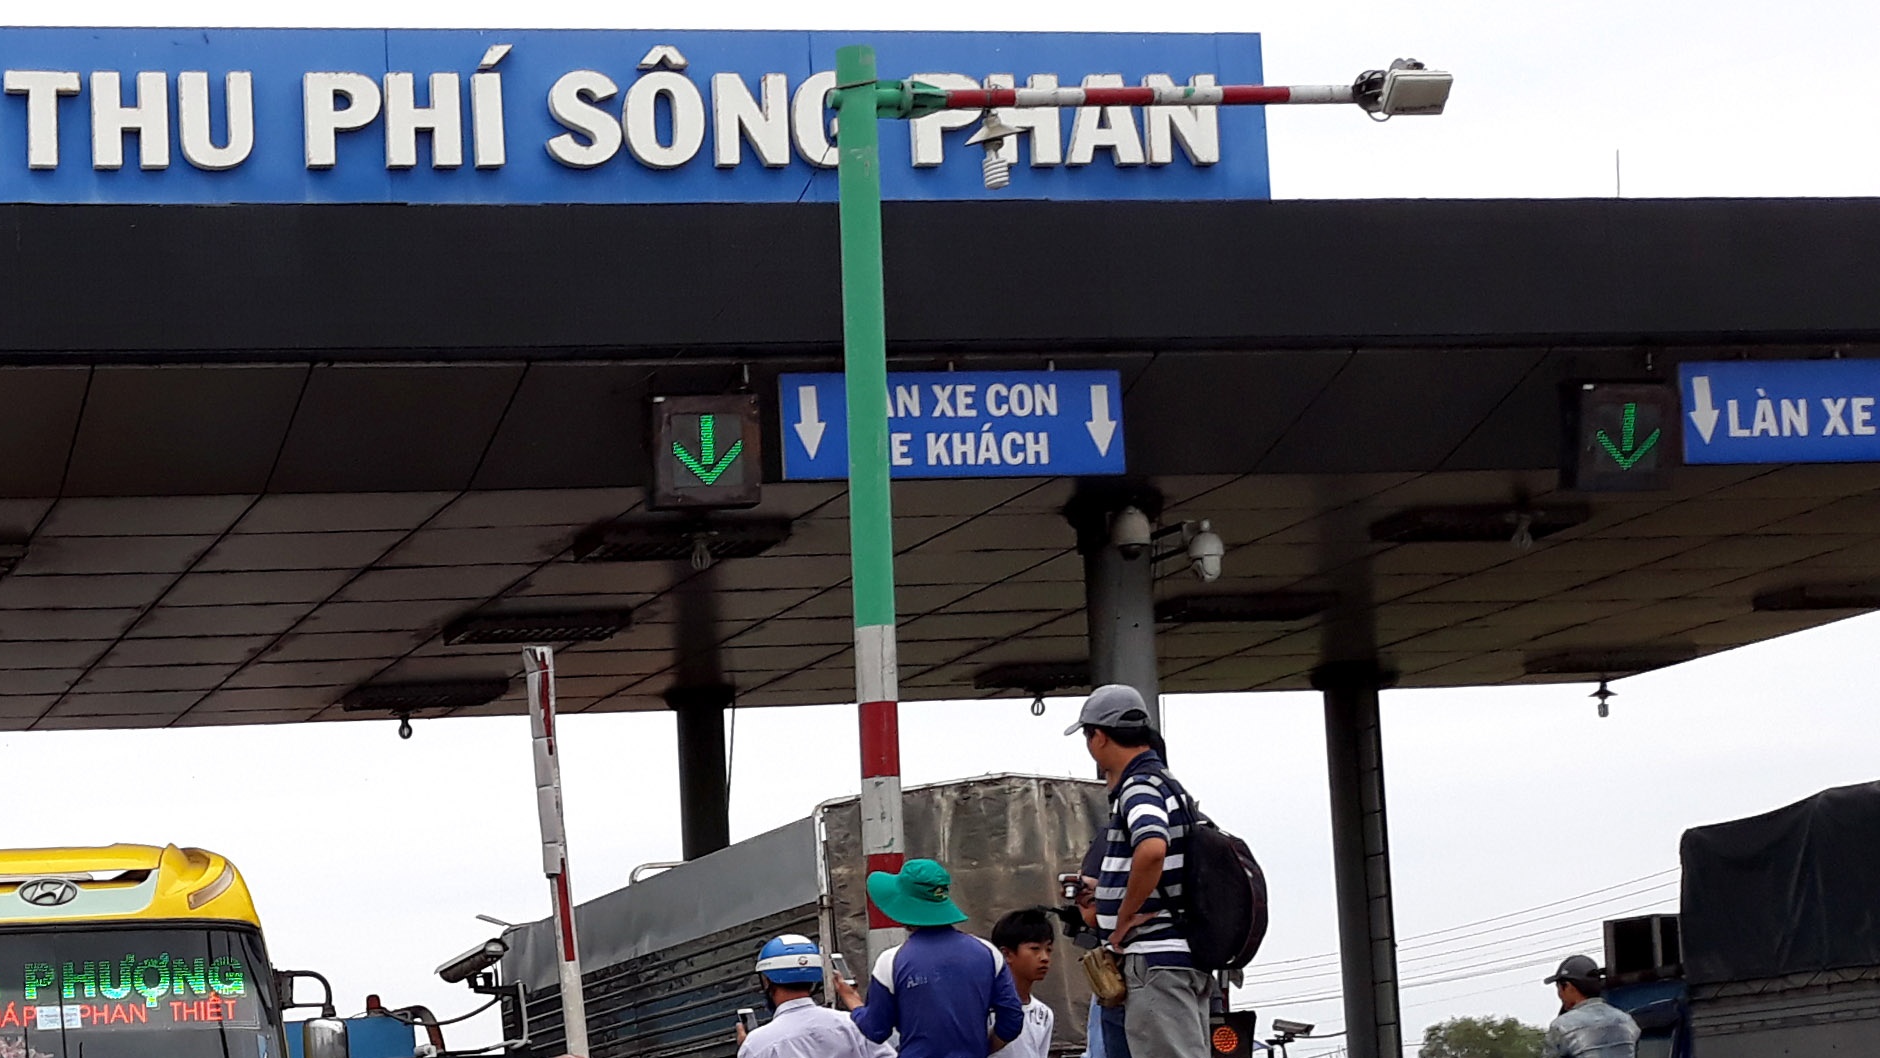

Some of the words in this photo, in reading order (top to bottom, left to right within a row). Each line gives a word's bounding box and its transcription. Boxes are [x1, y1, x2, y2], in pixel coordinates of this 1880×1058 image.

[3, 70, 255, 172] THU
[302, 43, 515, 170] PHÍ
[908, 72, 1220, 168] PHAN
[931, 384, 978, 418] XE
[985, 382, 1059, 417] CON
[1727, 388, 1810, 438] LÀN
[1822, 397, 1877, 437] XE
[926, 421, 1051, 466] KHÁCH
[24, 952, 248, 1008] PHƯỢNG
